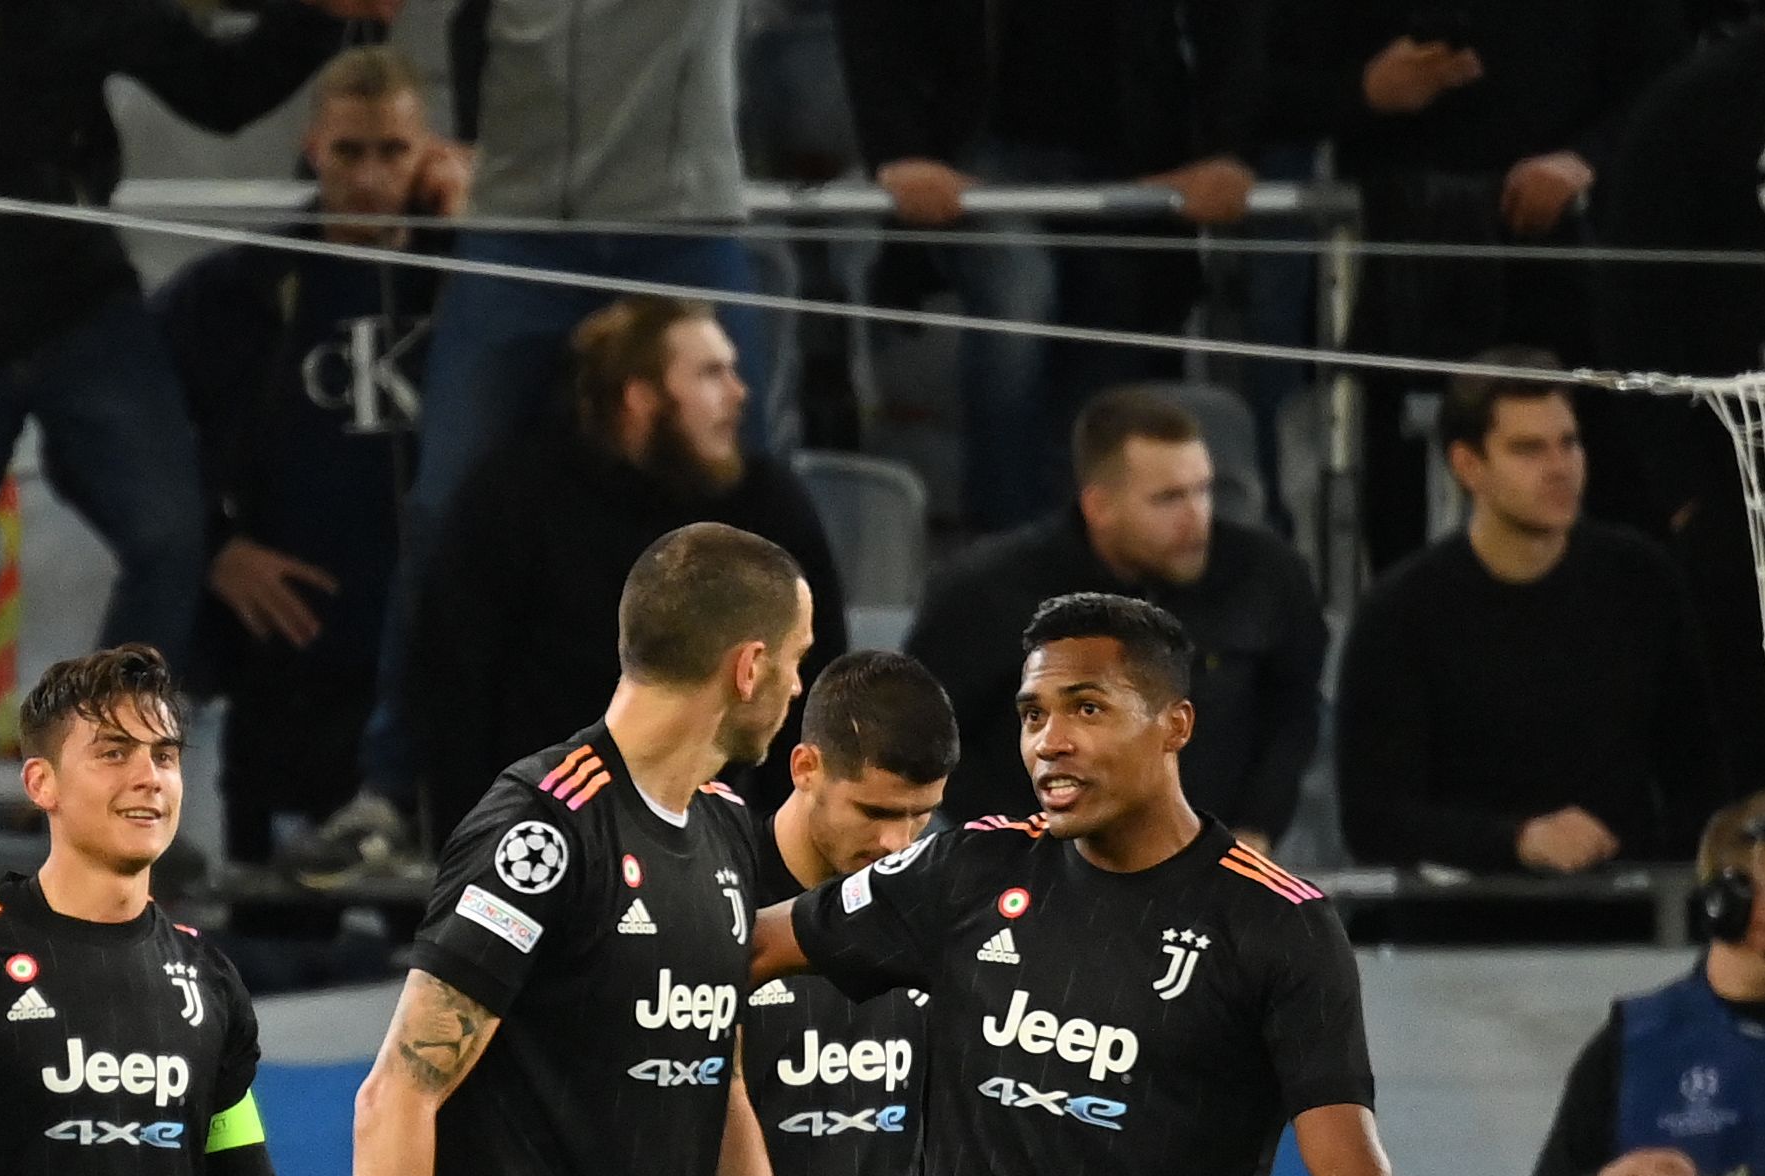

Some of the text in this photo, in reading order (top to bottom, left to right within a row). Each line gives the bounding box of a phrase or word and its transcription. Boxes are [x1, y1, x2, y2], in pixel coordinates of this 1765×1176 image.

[635, 968, 737, 1041] Jeep
[981, 989, 1140, 1082] Jeep
[41, 1037, 191, 1107] Jeep
[777, 1029, 913, 1093] Jeep
